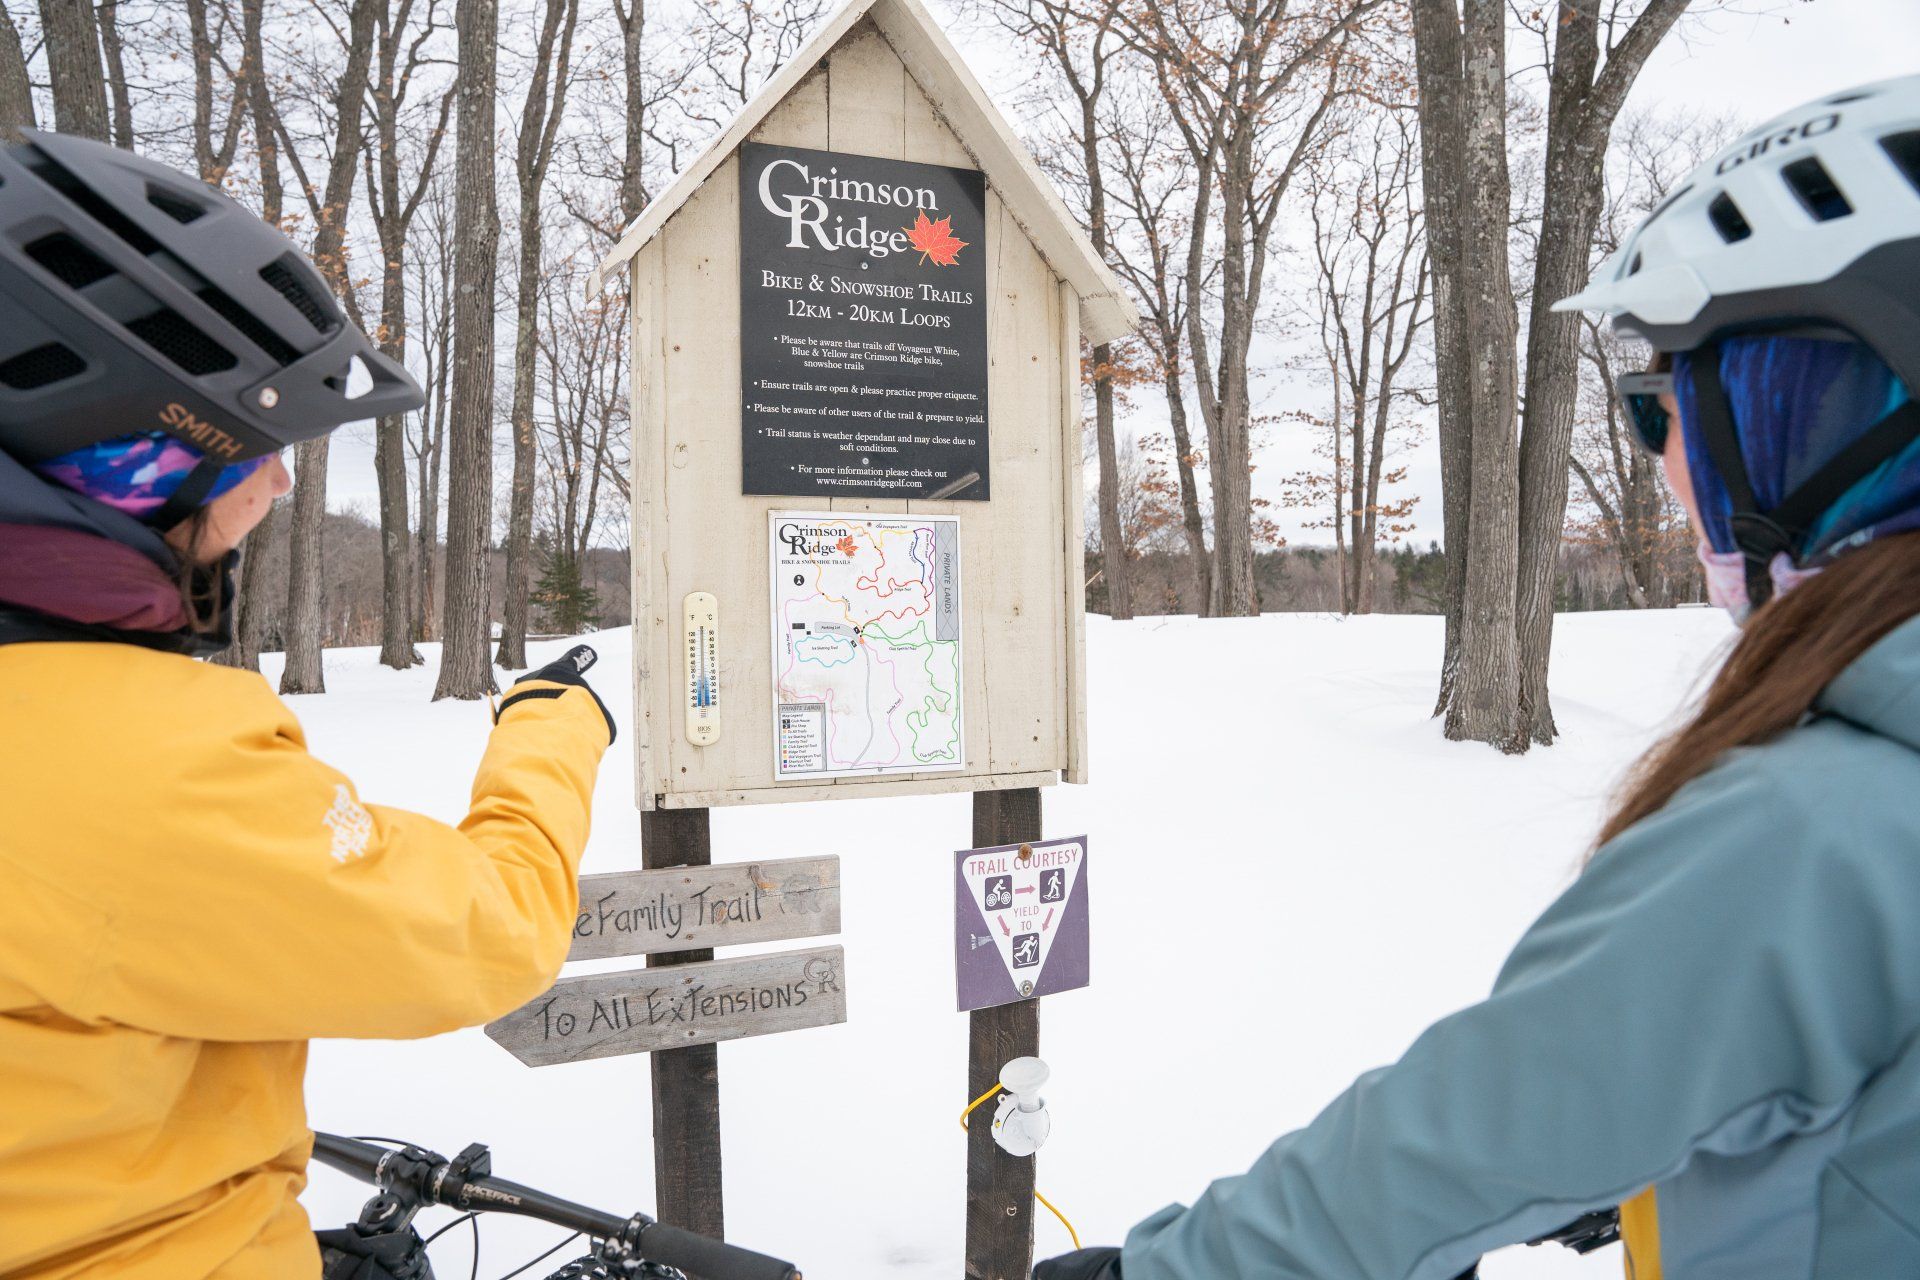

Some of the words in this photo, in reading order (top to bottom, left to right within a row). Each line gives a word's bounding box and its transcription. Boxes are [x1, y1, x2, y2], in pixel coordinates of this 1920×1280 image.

[758, 159, 939, 217] Crimson
[782, 194, 908, 258] Ridge
[761, 270, 803, 290] BIKE
[809, 275, 824, 292] &
[830, 276, 914, 300] SNOWSHOE
[919, 284, 973, 305] TRAILS
[900, 308, 951, 328] LOOPS
[781, 335, 806, 345] Please
[808, 337, 818, 346] be
[819, 339, 843, 348] aware
[844, 340, 861, 349] that
[862, 341, 883, 351] trails
[884, 343, 896, 351] off
[897, 343, 932, 355] Voyageur
[934, 346, 960, 357] White,
[792, 347, 810, 356] Blue
[811, 348, 820, 357] &
[822, 348, 848, 359] Yellow
[850, 352, 863, 360] are
[864, 351, 898, 362] Crimson
[900, 354, 923, 365] Ridge
[924, 356, 943, 367] bike,
[803, 360, 843, 369] snowshoe
[844, 362, 865, 371] trails
[761, 380, 790, 390] Ensure
[792, 382, 813, 391] trails
[814, 384, 828, 392] are
[829, 385, 849, 394] open
[851, 385, 859, 394] &
[860, 386, 884, 395] please
[885, 388, 916, 397] practice
[917, 391, 943, 400] proper
[944, 390, 979, 401] etiquette.
[754, 403, 780, 413] Please
[781, 405, 792, 414] be
[793, 407, 817, 416] aware
[818, 407, 828, 416] of
[828, 408, 850, 417] other
[851, 410, 872, 418] users
[873, 409, 883, 418] of
[883, 410, 896, 419] the
[898, 412, 914, 420] trail
[916, 412, 923, 420] &
[925, 414, 954, 423] prepare
[159, 402, 244, 459] SMITH
[765, 427, 786, 437] Trail
[787, 430, 811, 439] status
[813, 430, 821, 439] is
[822, 431, 853, 441] weather
[855, 432, 896, 443] dependant
[897, 434, 913, 443] and
[914, 437, 931, 445] may
[932, 436, 951, 445] close
[952, 436, 967, 445] due
[968, 438, 976, 446] to
[839, 443, 854, 451] soft
[856, 444, 899, 453] conditions.
[798, 464, 813, 474] For
[837, 465, 884, 476] information
[885, 467, 909, 477] please
[910, 469, 933, 478] check
[816, 477, 923, 488] www.crimsonridgegolf.com
[778, 523, 848, 544] Crimson
[788, 535, 836, 557] Ridge
[943, 552, 951, 585] PRIVATE
[944, 588, 952, 614] LANDS
[969, 858, 1008, 876] TRAIL
[1013, 848, 1078, 871] COURTESY
[690, 884, 762, 926] Trail
[1013, 905, 1040, 917] YIELD
[1020, 920, 1032, 931] TO
[588, 996, 632, 1033] All
[462, 1182, 522, 1206] RACEFACE
